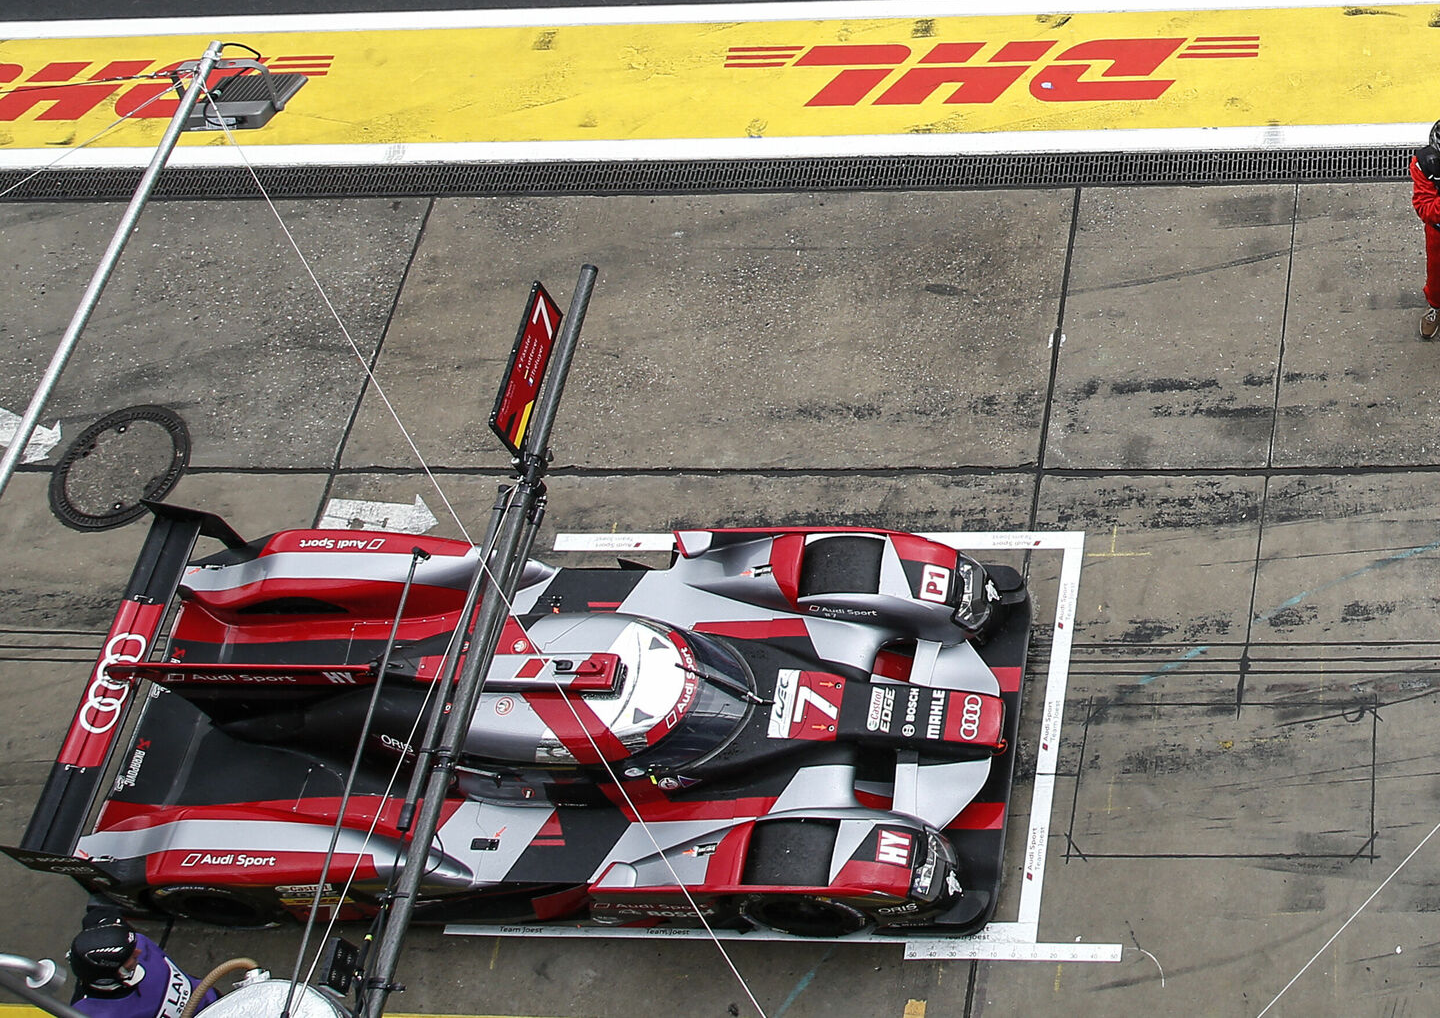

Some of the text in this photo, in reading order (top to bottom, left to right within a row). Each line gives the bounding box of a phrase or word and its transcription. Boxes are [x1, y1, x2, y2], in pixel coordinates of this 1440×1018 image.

[792, 37, 1188, 107] DHL
[532, 295, 553, 340] 7
[299, 538, 368, 550] Audi Sport
[925, 571, 946, 596] P1
[822, 606, 878, 617] Audi Sport
[191, 673, 297, 683] Audi Sport
[322, 671, 358, 684] HY
[677, 683, 696, 714] Audi
[793, 685, 839, 724] 7
[870, 690, 884, 721] Castrol
[879, 687, 896, 733] EDGE
[905, 687, 920, 722] BOSCH
[926, 689, 946, 740] MAHLE
[380, 733, 414, 753] ORIS
[200, 853, 276, 867] Audi Sport
[878, 830, 910, 866] HY
[616, 902, 654, 910] Audi
[878, 902, 918, 914] ORIS
[499, 925, 544, 934] Team Joest
[646, 927, 690, 937] Team Joest
[167, 969, 185, 1005] LAN
[175, 989, 189, 1014] 2016
